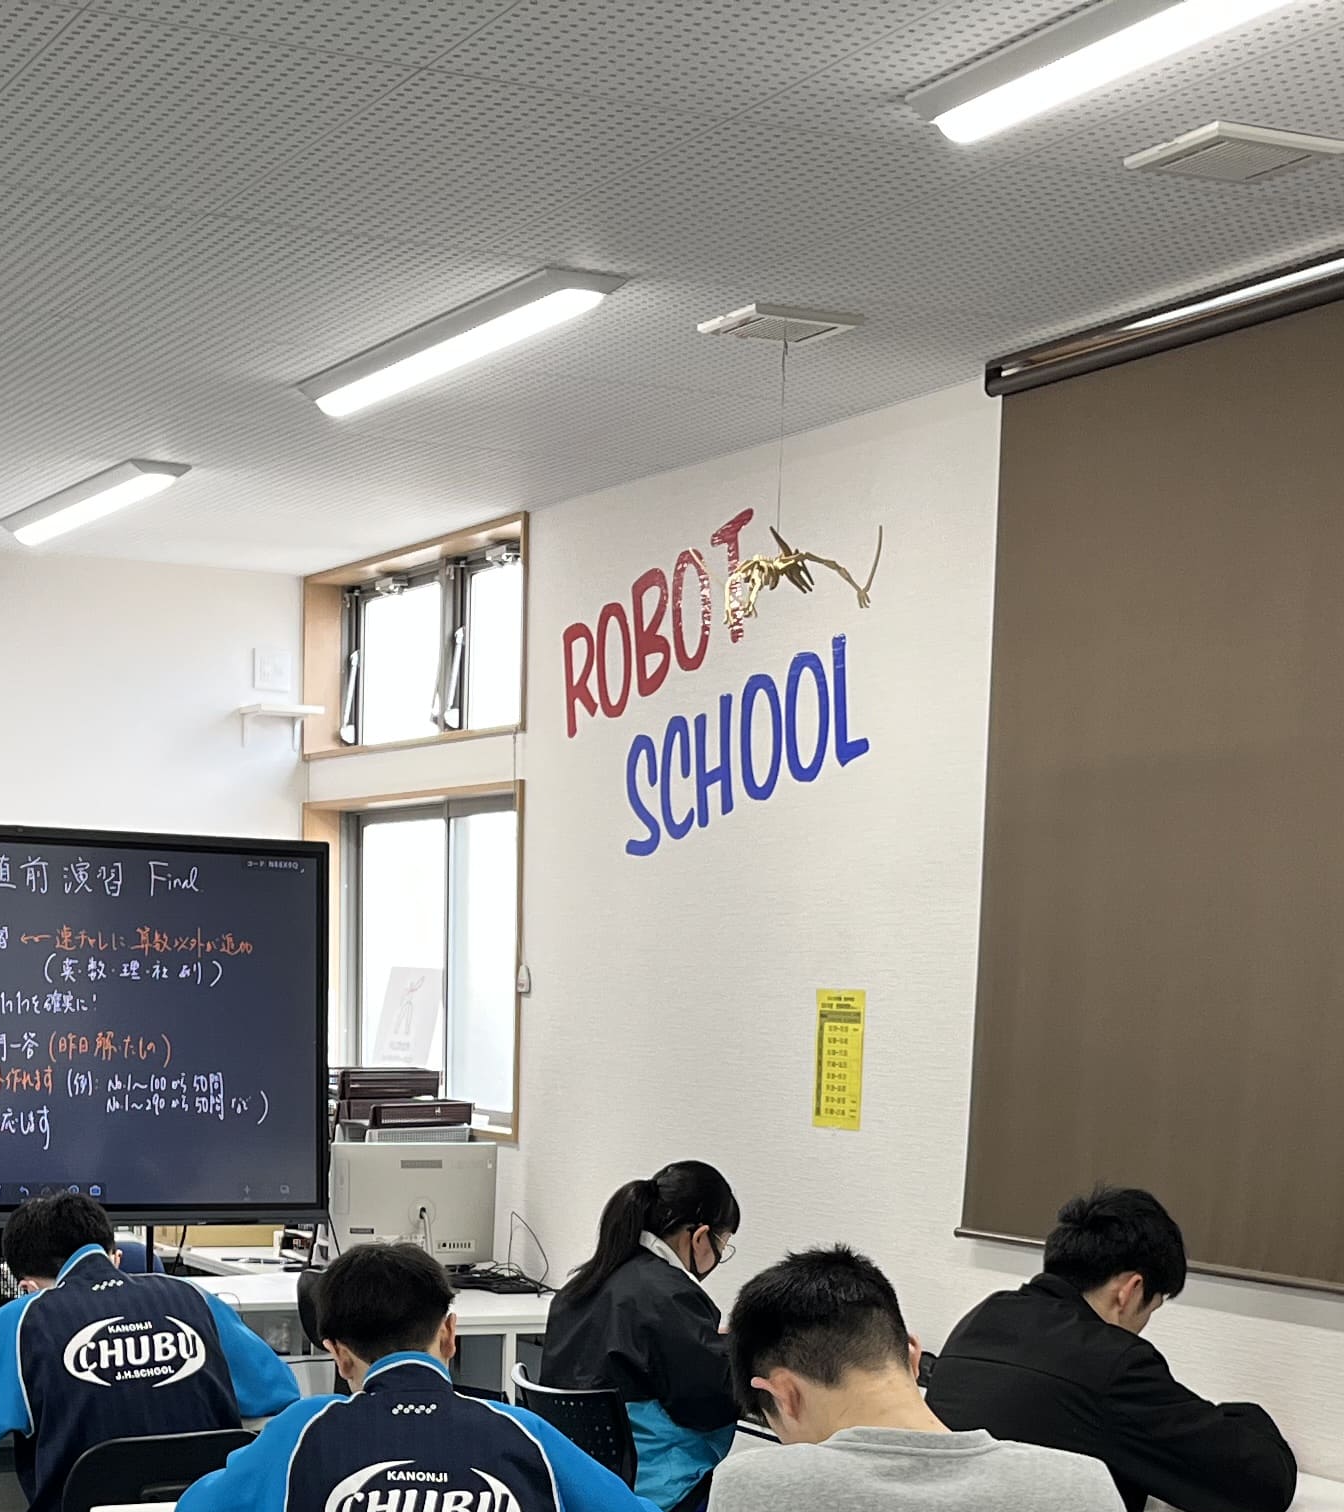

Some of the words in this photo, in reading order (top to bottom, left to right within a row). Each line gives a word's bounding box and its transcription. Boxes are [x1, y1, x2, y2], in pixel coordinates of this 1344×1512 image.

[562, 507, 754, 739] ROBOT
[625, 632, 870, 857] SCHOOL
[148, 860, 199, 897] Final
[107, 1321, 153, 1334] KANONJI
[75, 1331, 198, 1373] CHUBU
[387, 1470, 448, 1483] KANONJI
